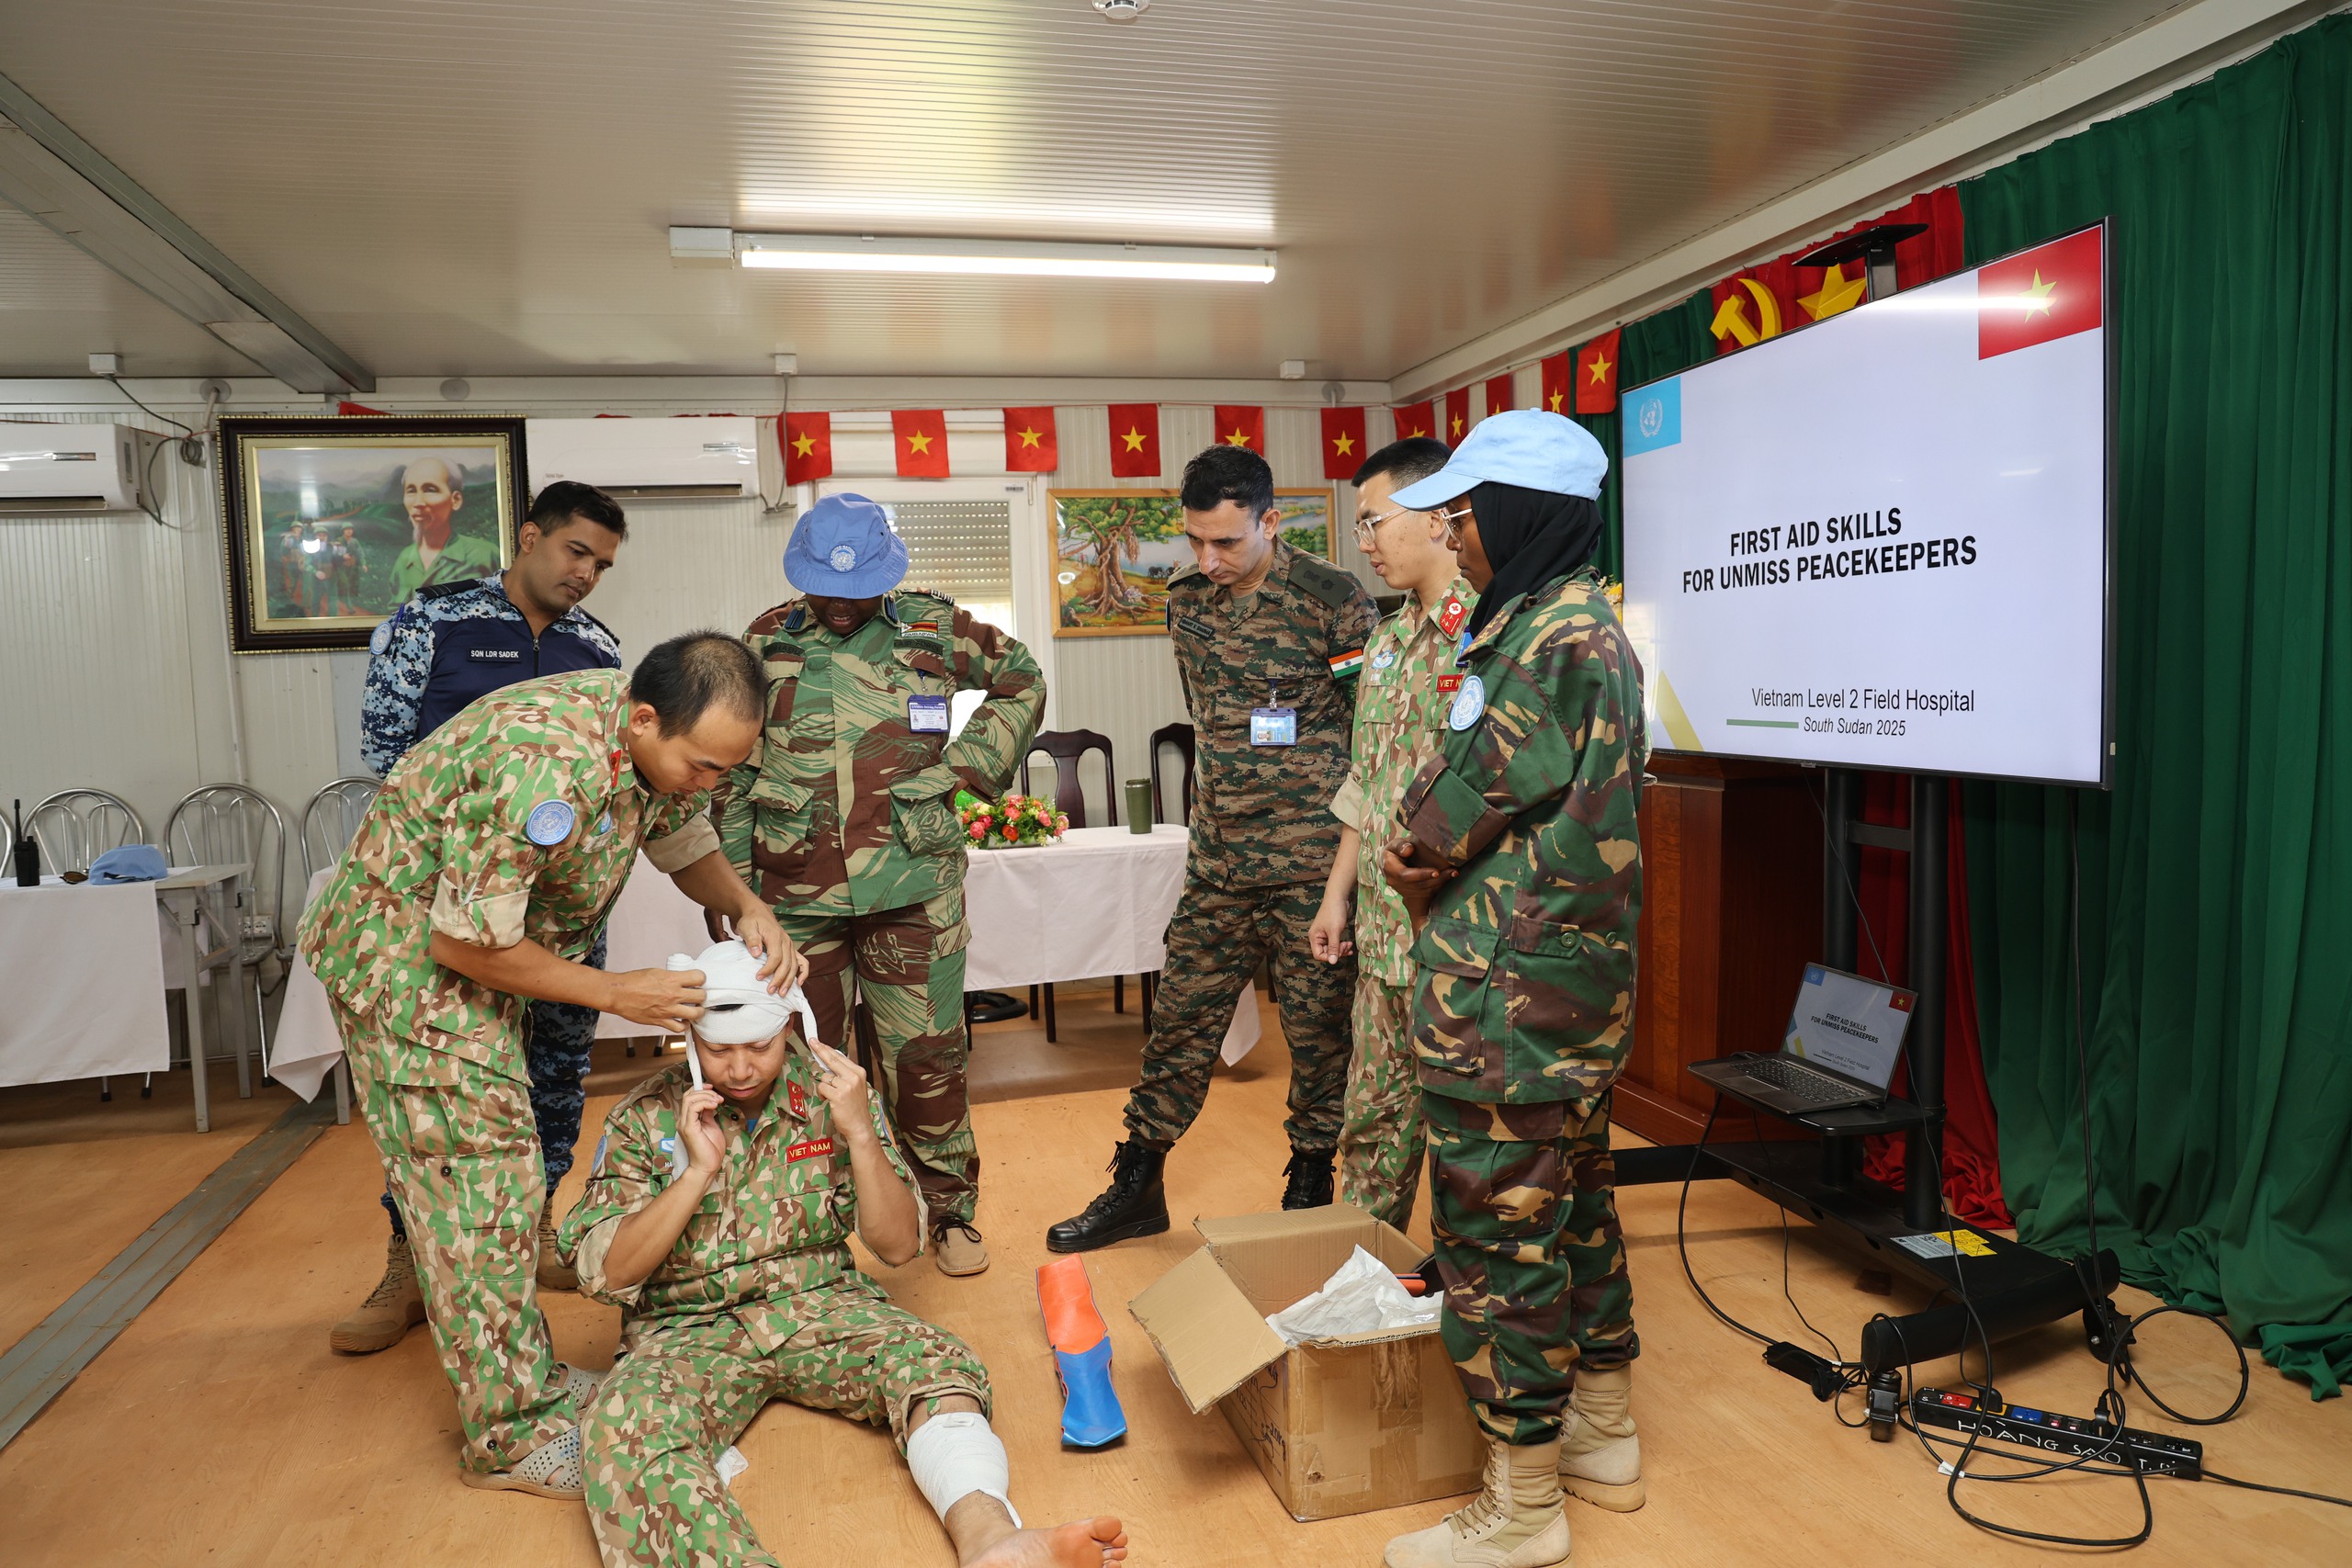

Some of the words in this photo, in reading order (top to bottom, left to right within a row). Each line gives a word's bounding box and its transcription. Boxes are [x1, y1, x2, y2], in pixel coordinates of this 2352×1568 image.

[1730, 526, 1781, 557] FIRST
[1786, 521, 1820, 549] AID
[1826, 507, 1902, 544] SKILLS
[1683, 569, 1714, 593] FOR
[1720, 558, 1790, 590] UNMISS
[1797, 536, 1977, 581] PEACEKEEPERS
[470, 649, 484, 658] SQN
[1440, 679, 1454, 688] VIET
[1752, 688, 1804, 708] Vietnam
[1808, 688, 1845, 709] Level
[1849, 689, 1859, 709] 2
[1863, 689, 1900, 710] Field
[1906, 689, 1974, 716] Hospital
[1804, 716, 1834, 733] South
[1838, 717, 1872, 735] Sudan
[1876, 719, 1906, 736] 2025
[1811, 1015, 1821, 1024] FOR
[1821, 1019, 1840, 1031] UNMISS
[1840, 1025, 1879, 1043] PEACEKEEPERS
[1826, 1013, 1840, 1024] FIRST
[1840, 1018, 1849, 1026] AID
[1849, 1021, 1867, 1031] SKILLS
[1835, 1053, 1844, 1061] Level
[1856, 1060, 1870, 1071] Hospital
[789, 1147, 807, 1158] VIET
[810, 1142, 831, 1154] NAM
